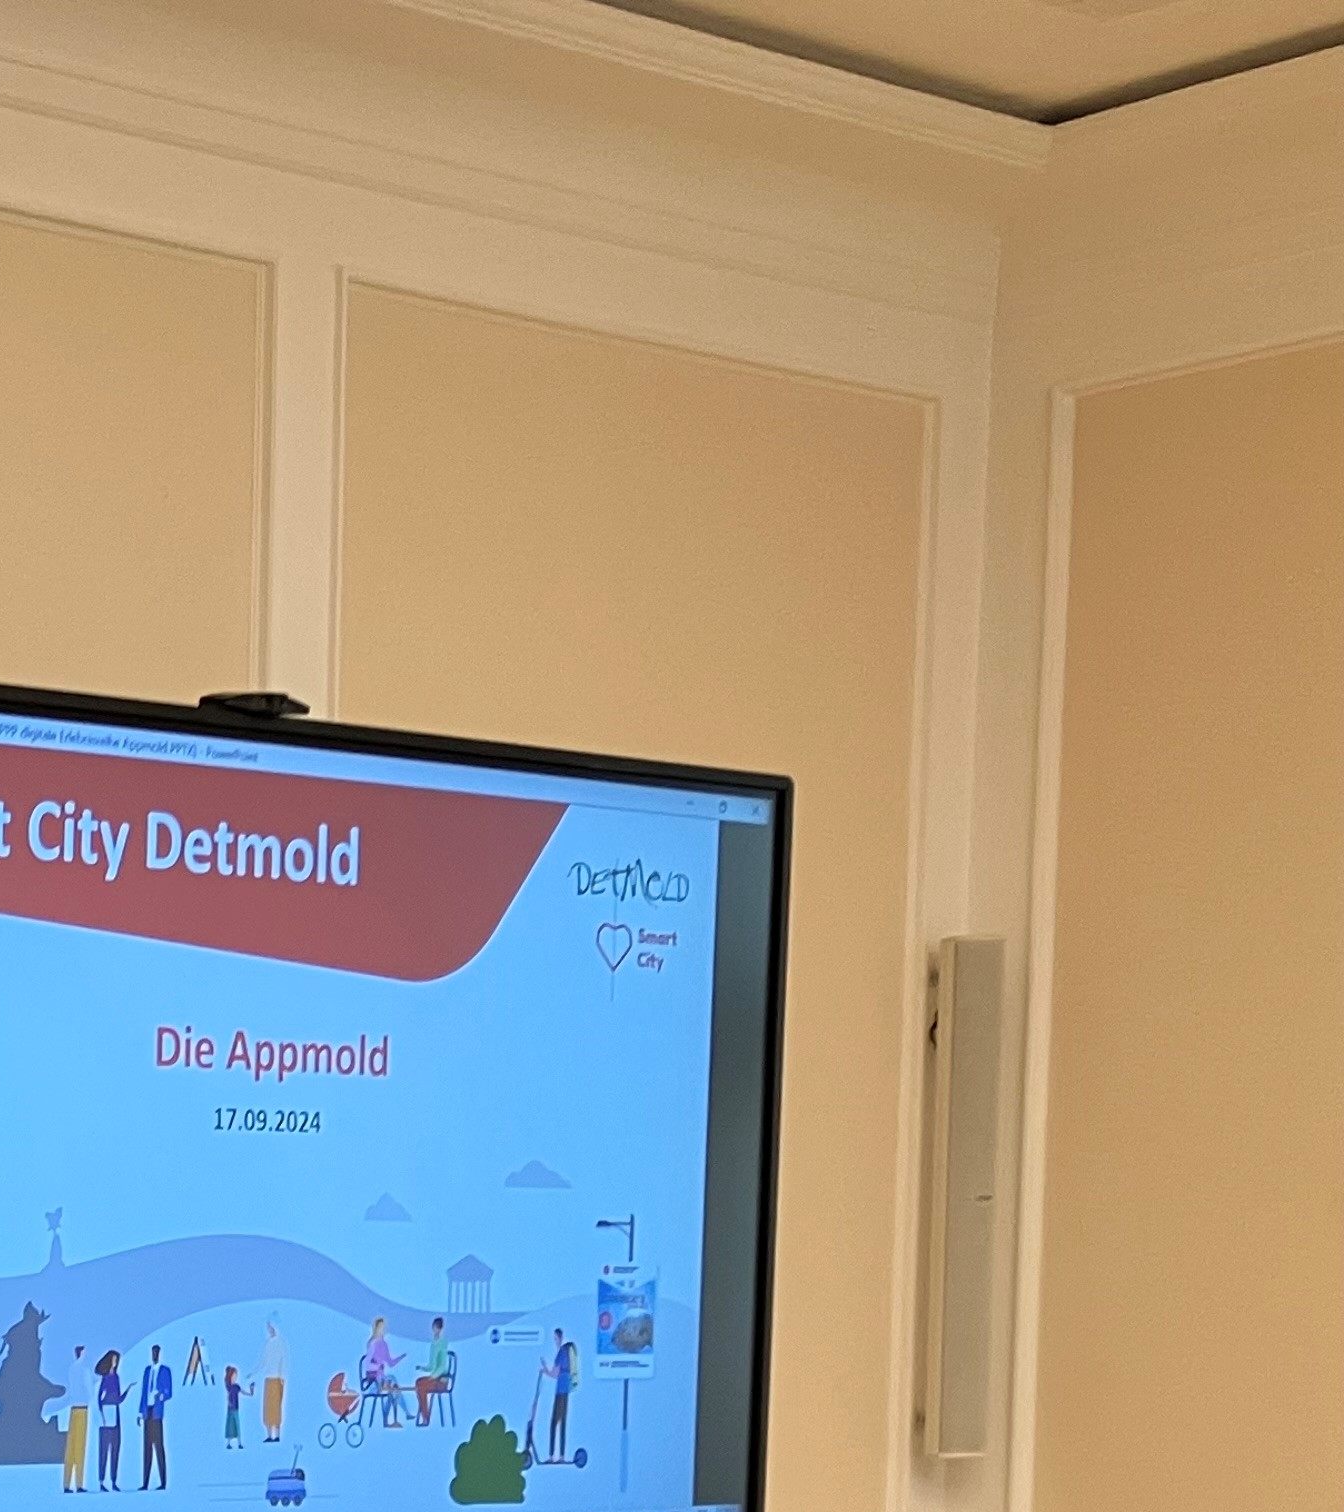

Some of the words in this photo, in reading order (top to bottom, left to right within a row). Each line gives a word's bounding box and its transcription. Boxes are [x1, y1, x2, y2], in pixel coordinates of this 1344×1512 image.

[27, 801, 130, 882] City
[145, 811, 359, 887] Detmold
[637, 927, 679, 948] Smart
[636, 951, 665, 974] City
[156, 1026, 215, 1069] Die
[226, 1030, 389, 1084] Appmold
[214, 1107, 322, 1134] 17.09.2024
